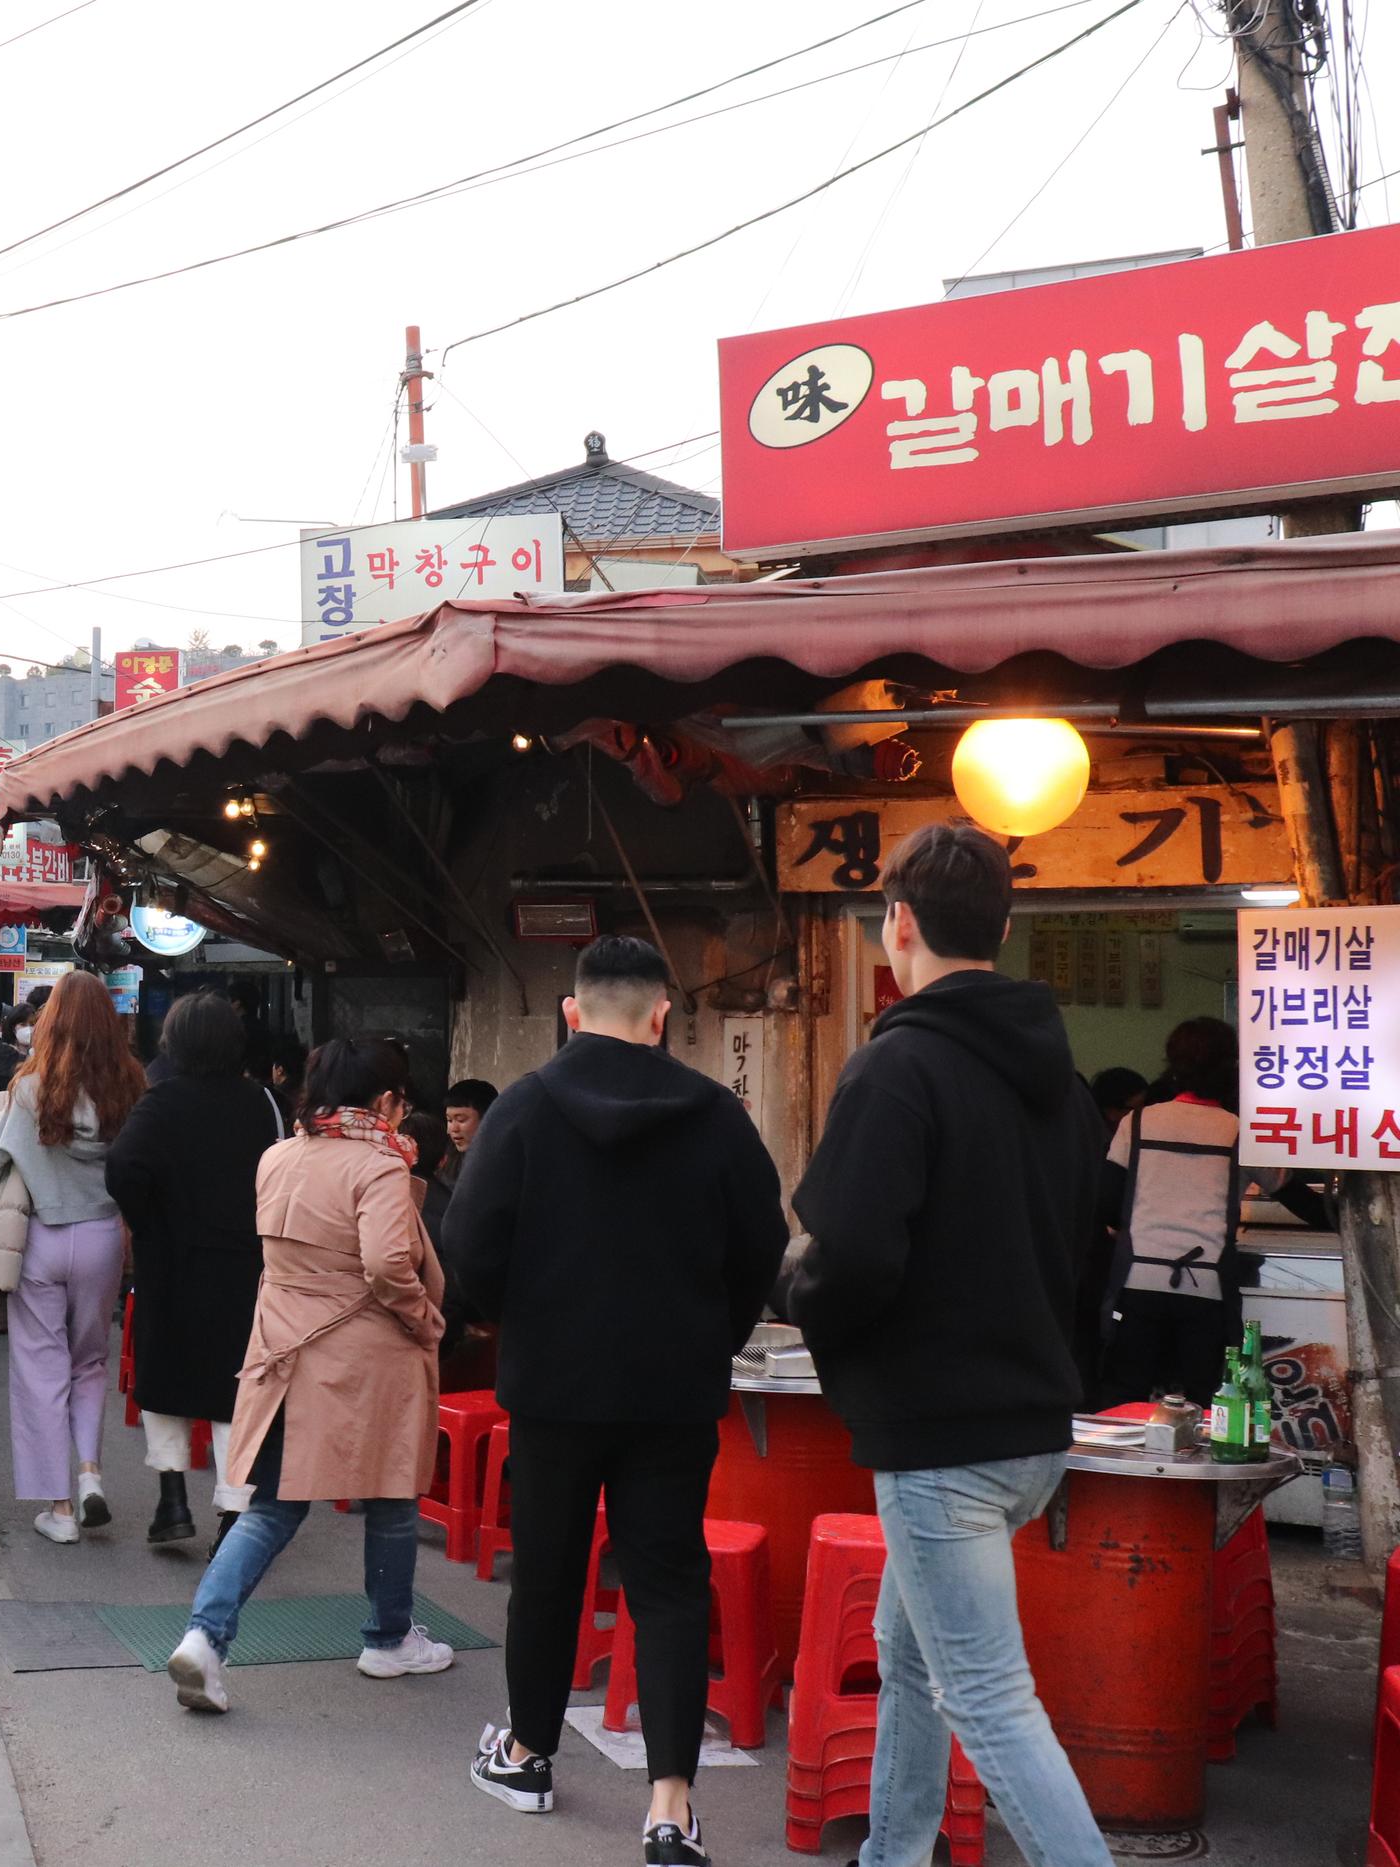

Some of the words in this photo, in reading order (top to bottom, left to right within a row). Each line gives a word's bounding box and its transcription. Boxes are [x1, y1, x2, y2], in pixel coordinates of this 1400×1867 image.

[776, 365, 850, 423] 味
[316, 537, 357, 642] 고창
[367, 538, 543, 590] 막창구이
[793, 796, 1223, 888] 생기
[1253, 926, 1375, 971] 갈매기살
[1250, 985, 1372, 1030] 가브리살
[1253, 1045, 1375, 1090] 항정살
